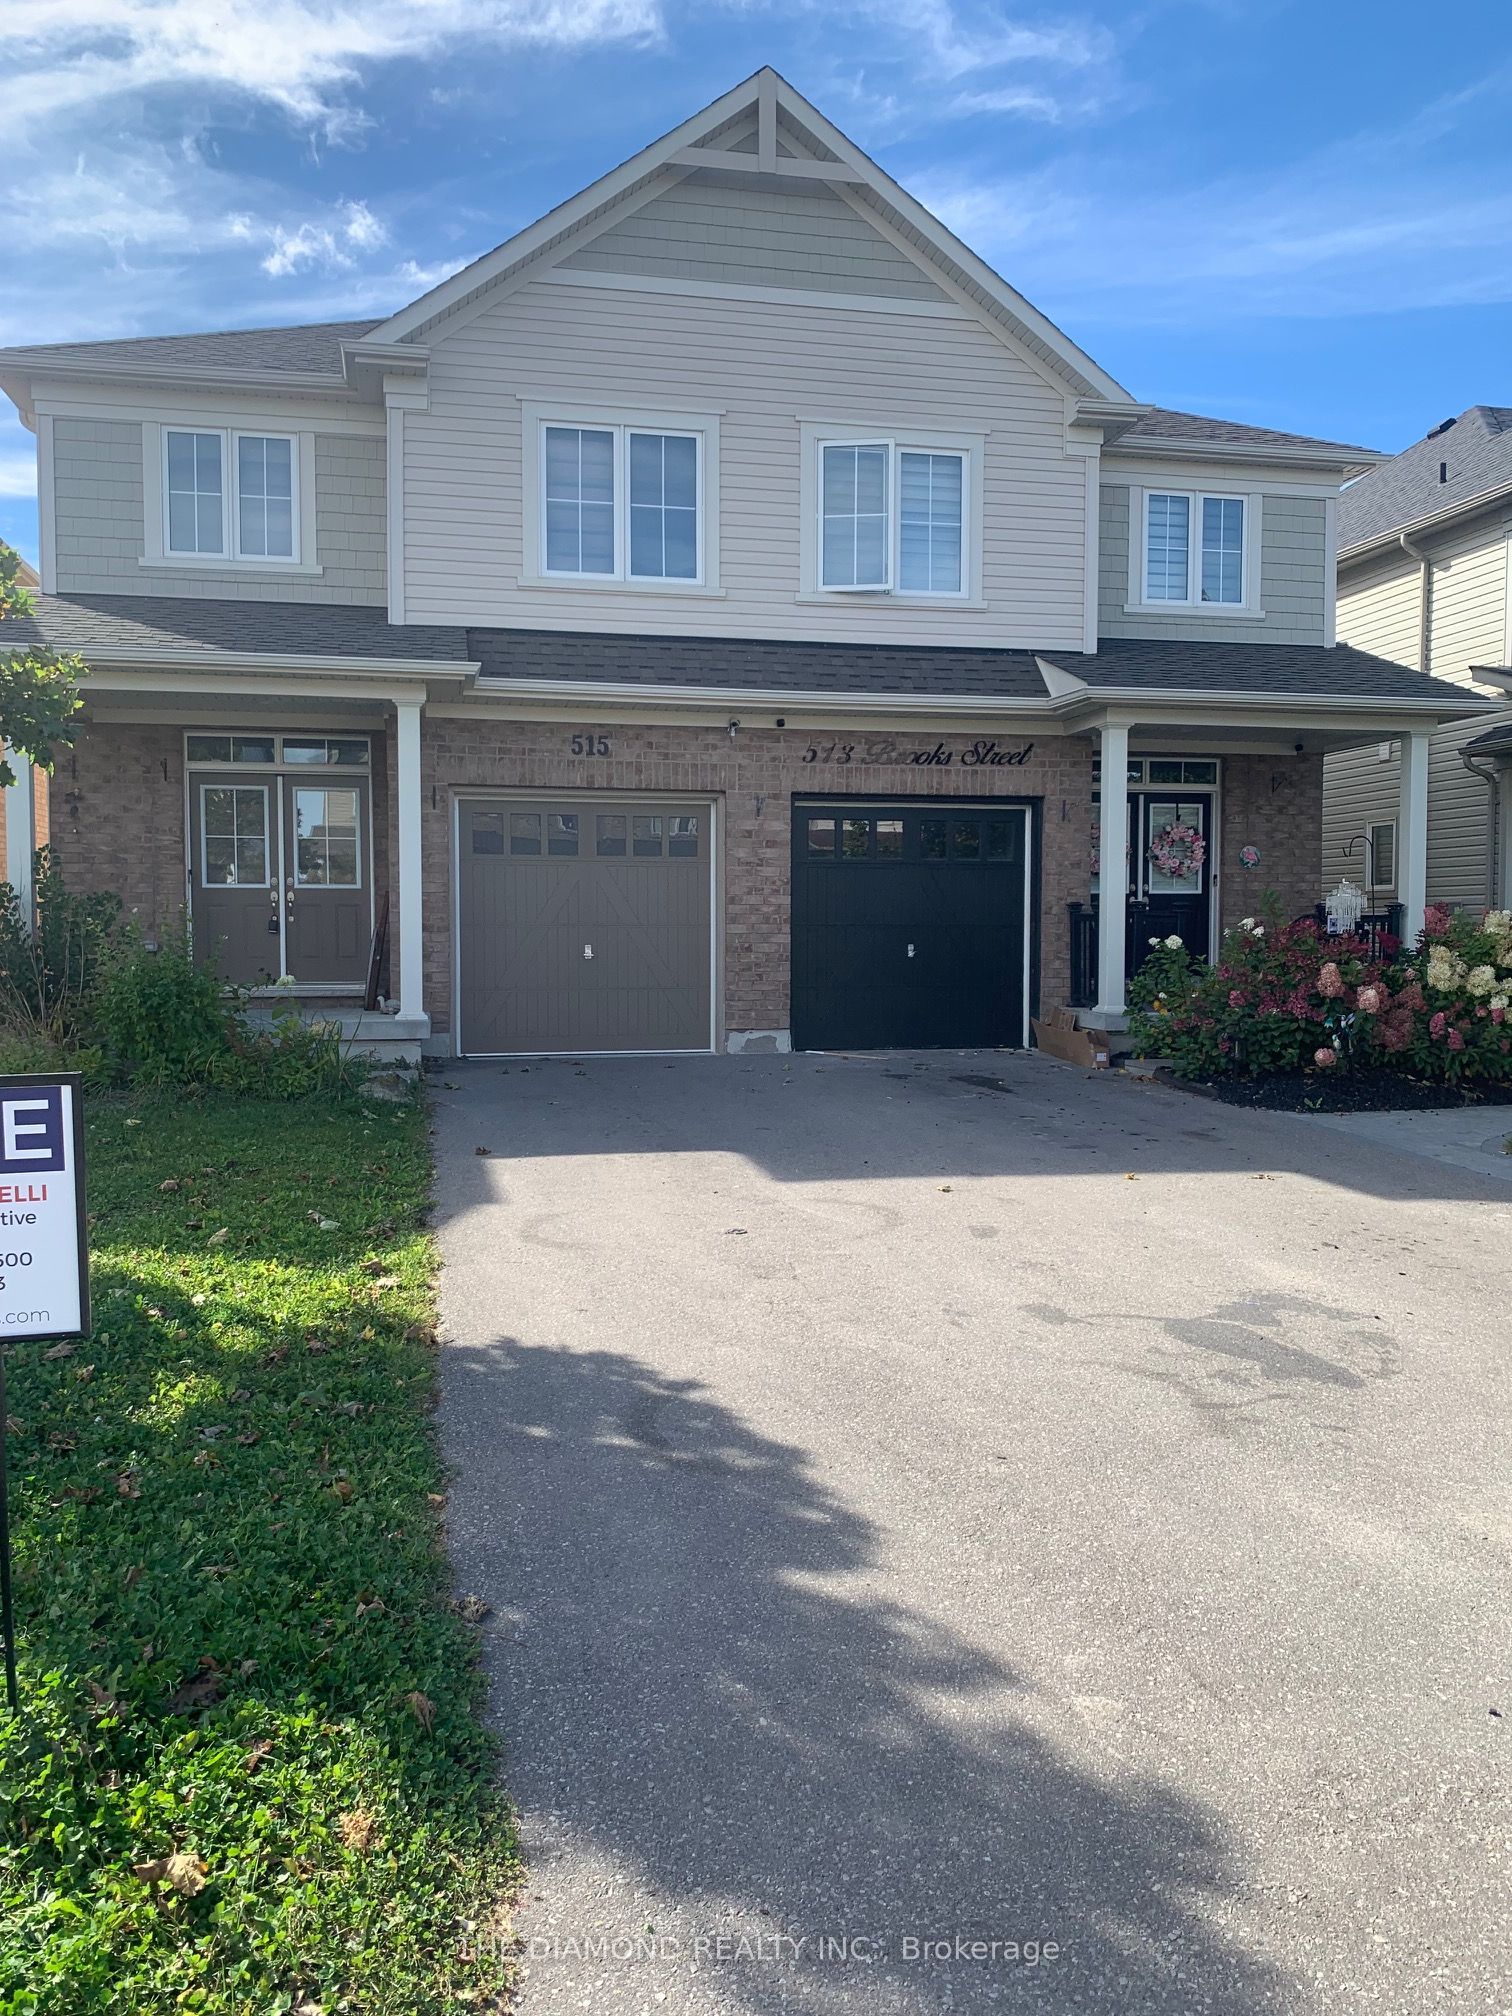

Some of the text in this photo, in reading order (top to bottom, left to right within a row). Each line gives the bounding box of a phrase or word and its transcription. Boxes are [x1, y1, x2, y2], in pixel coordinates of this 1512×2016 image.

[571, 734, 609, 756] 515
[802, 743, 855, 764] 513
[961, 740, 1034, 766] Street
[3, 1099, 52, 1160] E
[0, 1184, 47, 1203] ELLI
[0, 1210, 37, 1226] tive
